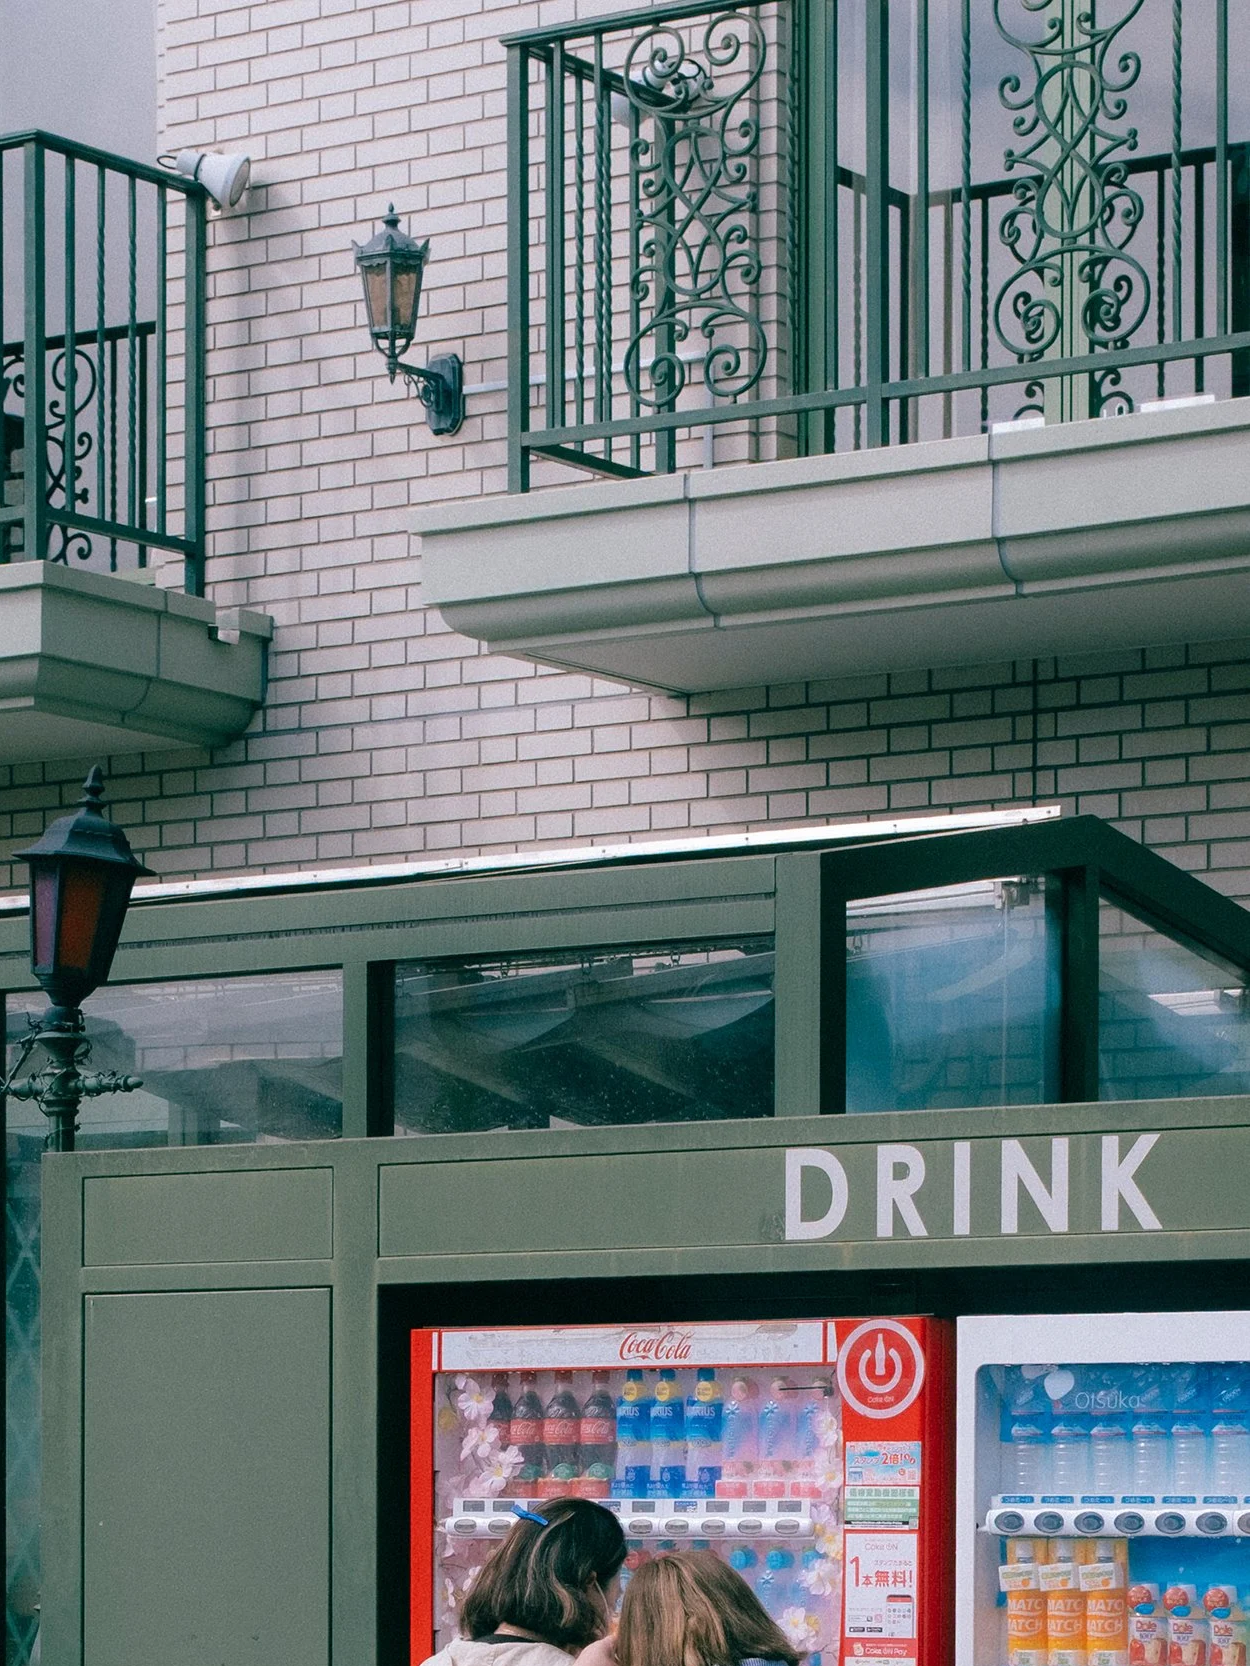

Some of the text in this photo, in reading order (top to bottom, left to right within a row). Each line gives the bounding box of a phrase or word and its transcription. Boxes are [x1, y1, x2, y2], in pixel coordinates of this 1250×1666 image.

[785, 1134, 1163, 1241] DRINK
[619, 1331, 695, 1360] Coca-Cola
[1075, 1391, 1140, 1409] Otsuka
[1136, 1620, 1157, 1630] Dole
[1173, 1622, 1193, 1632] Dole
[1213, 1624, 1233, 1634] Dole
